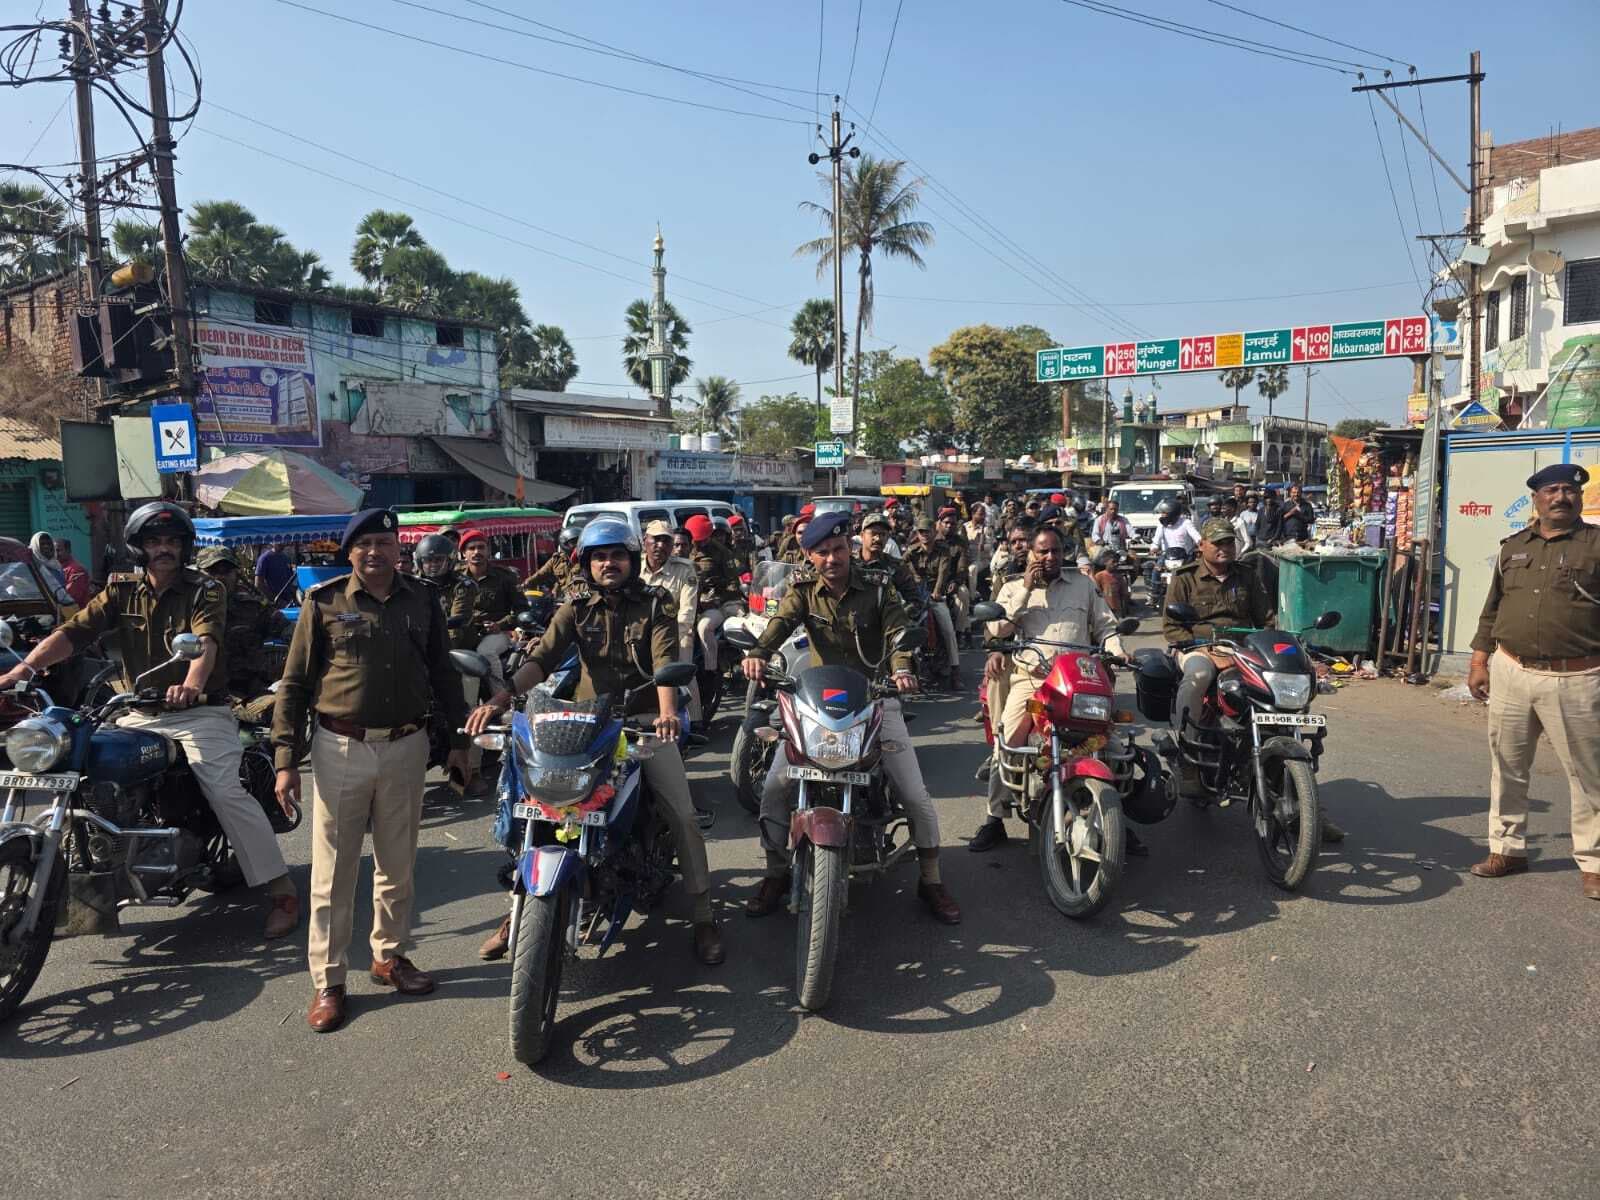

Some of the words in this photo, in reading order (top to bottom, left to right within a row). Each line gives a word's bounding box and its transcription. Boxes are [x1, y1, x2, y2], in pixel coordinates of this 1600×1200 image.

[1406, 324, 1423, 336] 29
[228, 333, 246, 346] ENT
[272, 339, 280, 350] &
[1308, 332, 1329, 343] 100
[1198, 343, 1212, 353] 75
[1332, 342, 1385, 355] Akbarnagar
[1403, 337, 1424, 350] K.M
[1118, 350, 1134, 359] 250
[1244, 349, 1286, 362] Jamui
[1308, 344, 1329, 356] K.M
[1137, 358, 1177, 371] Munger
[1194, 354, 1213, 365] K.M
[1045, 367, 1055, 376] 85
[1062, 366, 1096, 375] Patna
[1118, 361, 1135, 371] K.M
[157, 459, 178, 468] EATING
[179, 458, 198, 468] PLACE
[1459, 501, 1492, 517] महिला
